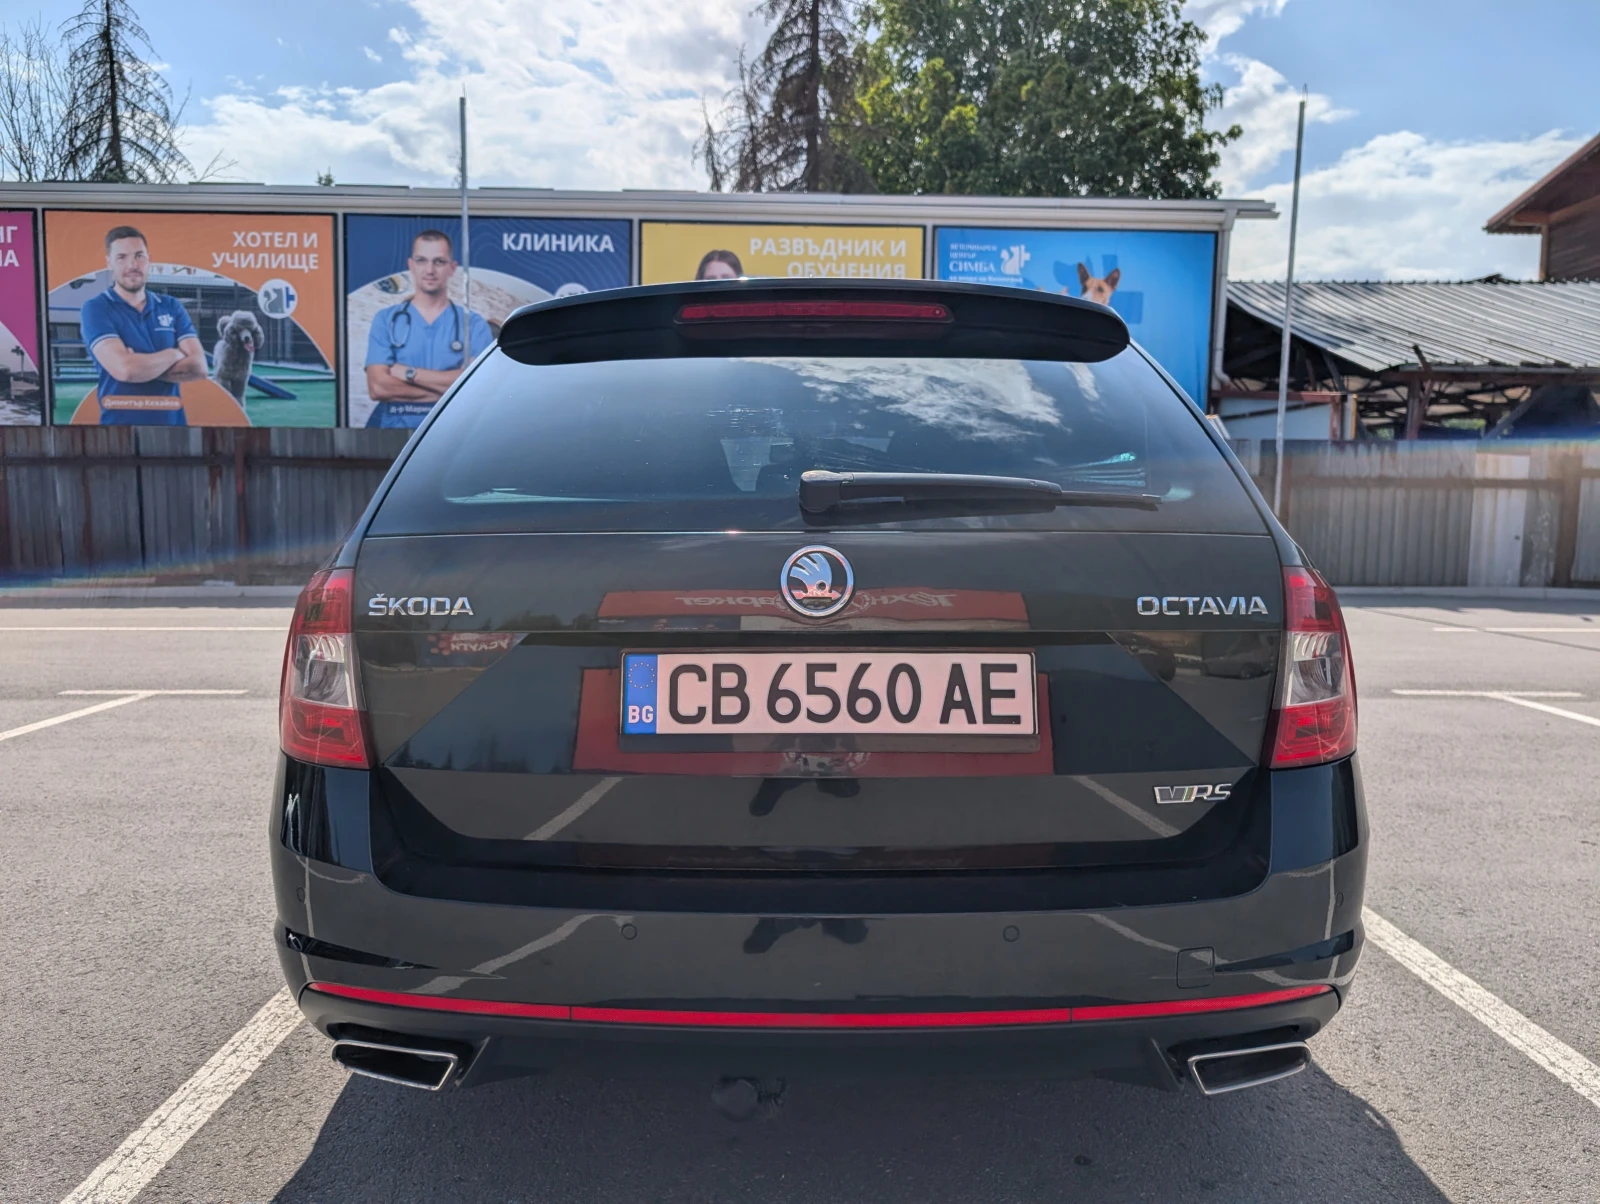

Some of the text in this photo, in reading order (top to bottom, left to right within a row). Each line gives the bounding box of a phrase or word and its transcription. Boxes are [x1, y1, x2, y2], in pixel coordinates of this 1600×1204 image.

[232, 231, 318, 248] ХОТЕЛ И
[502, 232, 615, 253] КЛИНИКА
[750, 238, 907, 260] РАЗВЪДНИК И
[211, 252, 319, 273] УЧИЛИЩЕ
[787, 261, 907, 279] ОБУЧЕНИЯ
[949, 260, 996, 273] СИМБА
[368, 593, 474, 616] ŠKODA
[1136, 596, 1268, 616] OCTAVIA
[668, 663, 1021, 724] CB 6560 AE
[628, 705, 654, 723] BG
